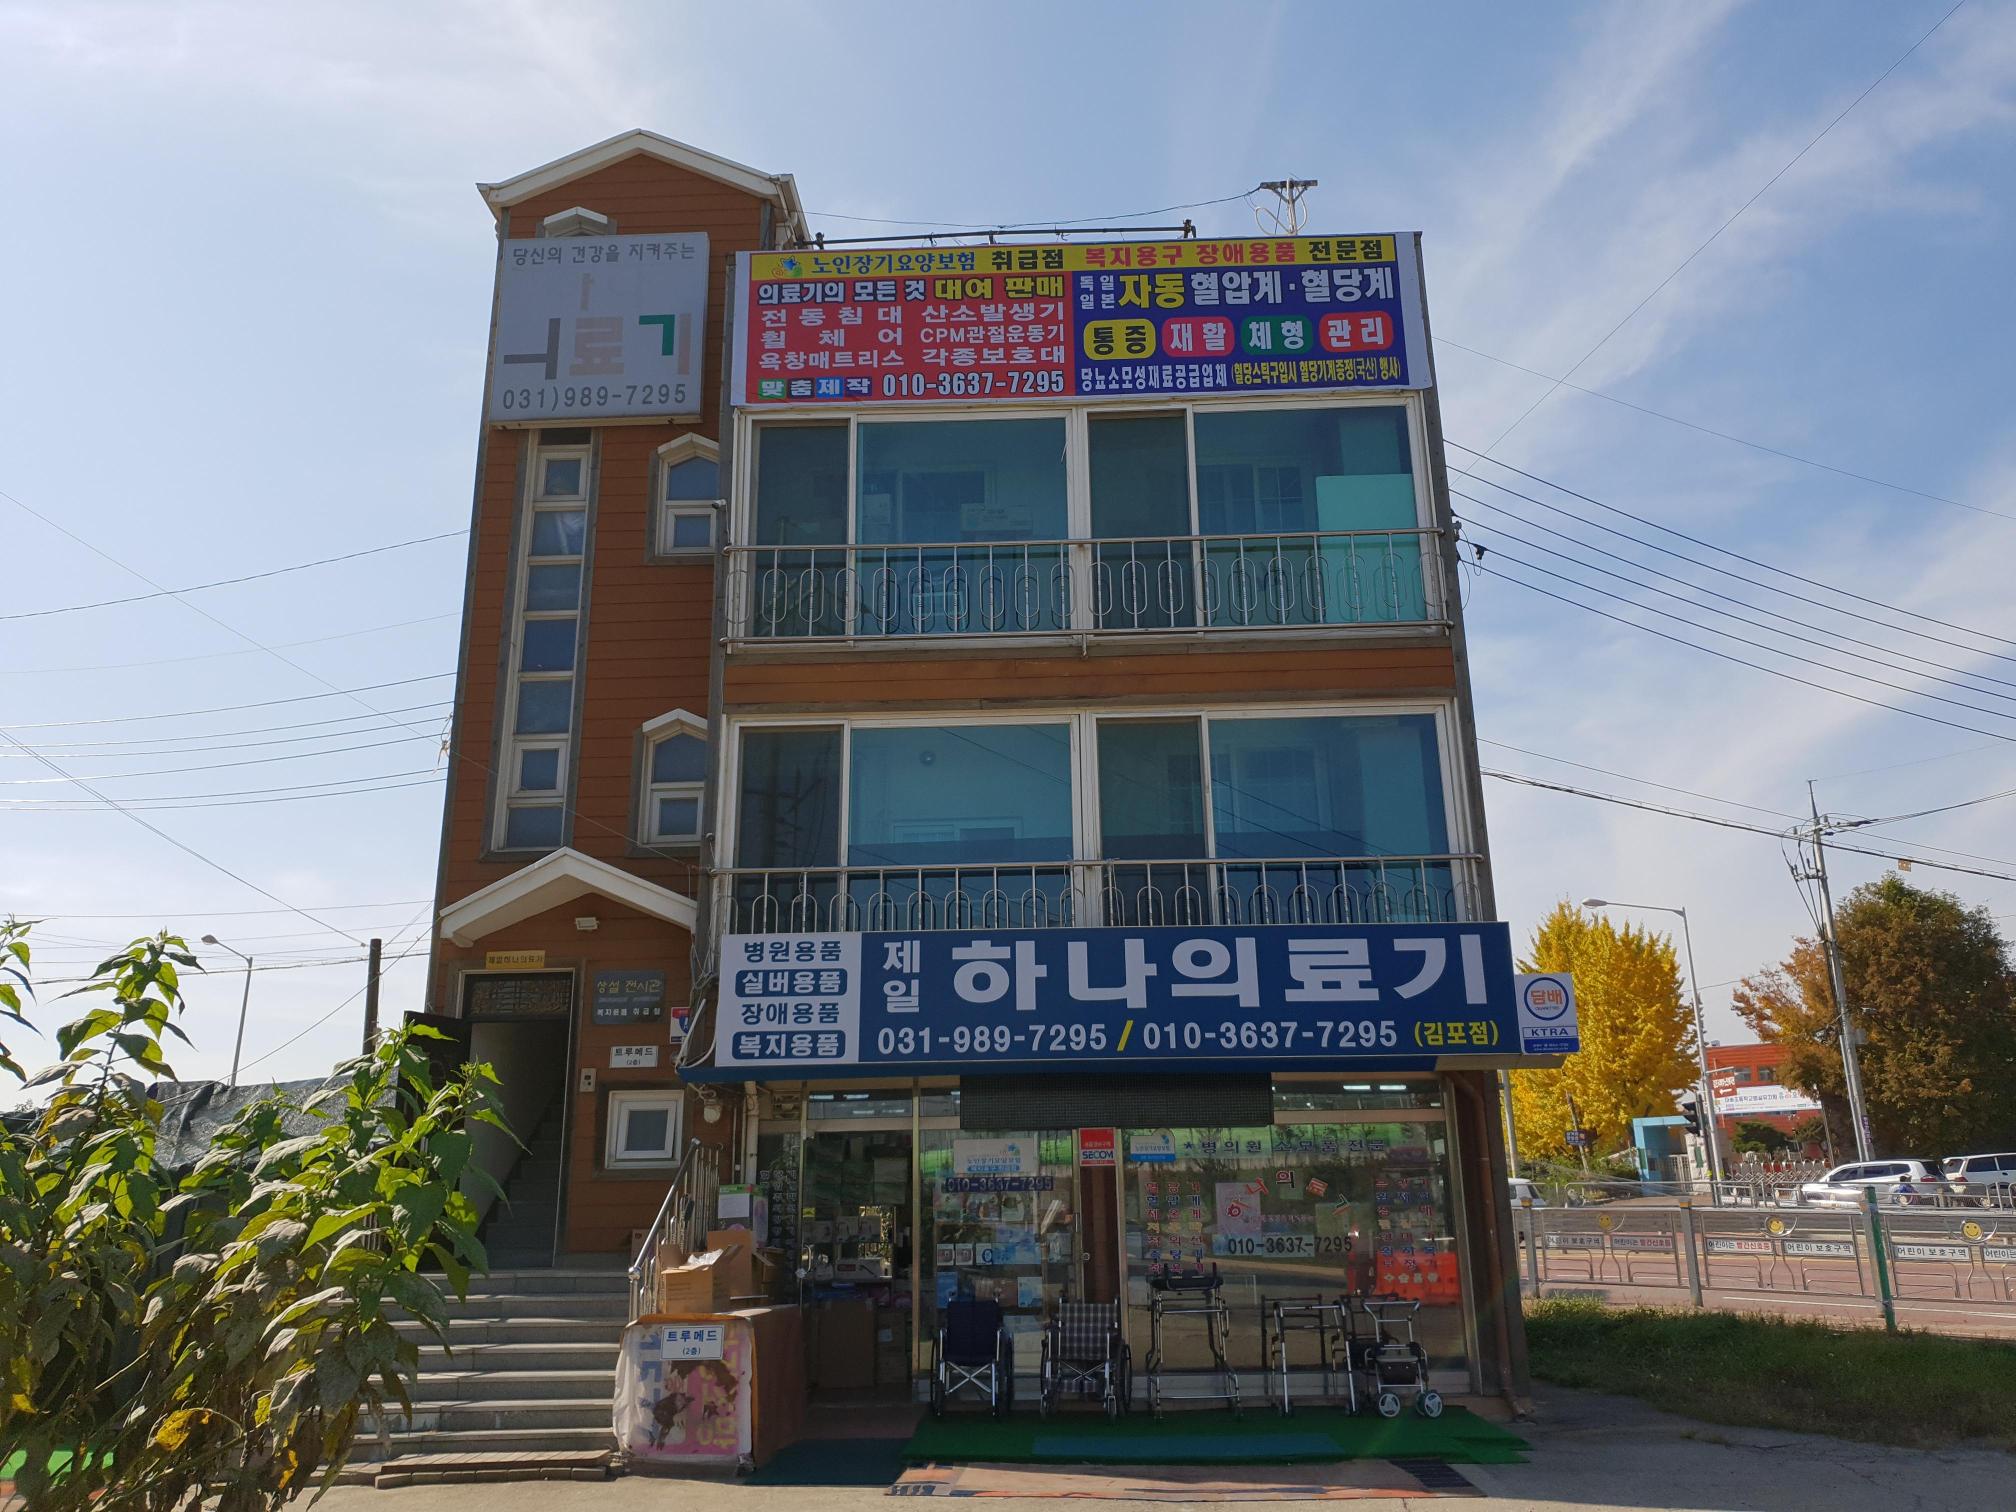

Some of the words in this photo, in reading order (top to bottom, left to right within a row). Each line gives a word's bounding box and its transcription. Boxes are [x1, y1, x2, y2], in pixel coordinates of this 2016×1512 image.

[512, 247, 562, 266] 당신의
[571, 244, 620, 263] 건강을
[629, 242, 695, 260] 지켜주는
[811, 252, 976, 275] 노인장기요양보험
[991, 249, 1064, 271] 취급점
[1085, 244, 1185, 268] 복지용구
[1196, 242, 1297, 265] 장애용품
[1308, 239, 1383, 263] 전문점
[758, 282, 846, 304] 의료기의
[854, 280, 897, 302] 모든
[904, 279, 926, 302] 것
[934, 277, 993, 300] 대여
[1005, 275, 1065, 299] 판매
[1118, 272, 1185, 309] 자동
[921, 301, 1064, 323] 산소발생기
[920, 323, 1064, 344] CPM관절운동기
[1092, 325, 1147, 356] 통증
[1170, 322, 1226, 352] 재활
[1249, 320, 1305, 350] 체형
[1327, 316, 1384, 348] 관리
[759, 349, 905, 371] 욕창매트리스
[921, 345, 1065, 367] 각종보호대
[761, 377, 870, 396] 맞춤제작
[882, 370, 1065, 397] 010-3637-7295
[1081, 363, 1228, 392] 당뇨소모성재료공급업체
[503, 383, 686, 411] 031)989-7295
[744, 940, 842, 963] 병원용품
[741, 970, 841, 995] 실버용품
[951, 933, 1489, 1011] 하나의료기
[1530, 989, 1563, 1005] 담배
[741, 1002, 840, 1026] 장애용품
[738, 1032, 840, 1057] 복지용품
[877, 1023, 1107, 1055] 031-989-7295
[1143, 1020, 1398, 1050] 010-3637-7295
[1414, 1019, 1499, 1047] (김포점)
[1531, 1028, 1569, 1037] KTRA
[1082, 1151, 1114, 1160] SECOM
[947, 1177, 1053, 1192] 010-3637-7295
[1228, 1236, 1352, 1255] 010-3637-7295
[1708, 1240, 1735, 1249] 어린이는
[1736, 1241, 1770, 1251] 빨간신호등
[1787, 1242, 1813, 1253] 어린이
[1816, 1243, 1851, 1255] 보호구역
[1898, 1247, 1925, 1257] 어린이
[1929, 1247, 1967, 1258] 보호구역
[666, 1330, 717, 1342] 트루메드
